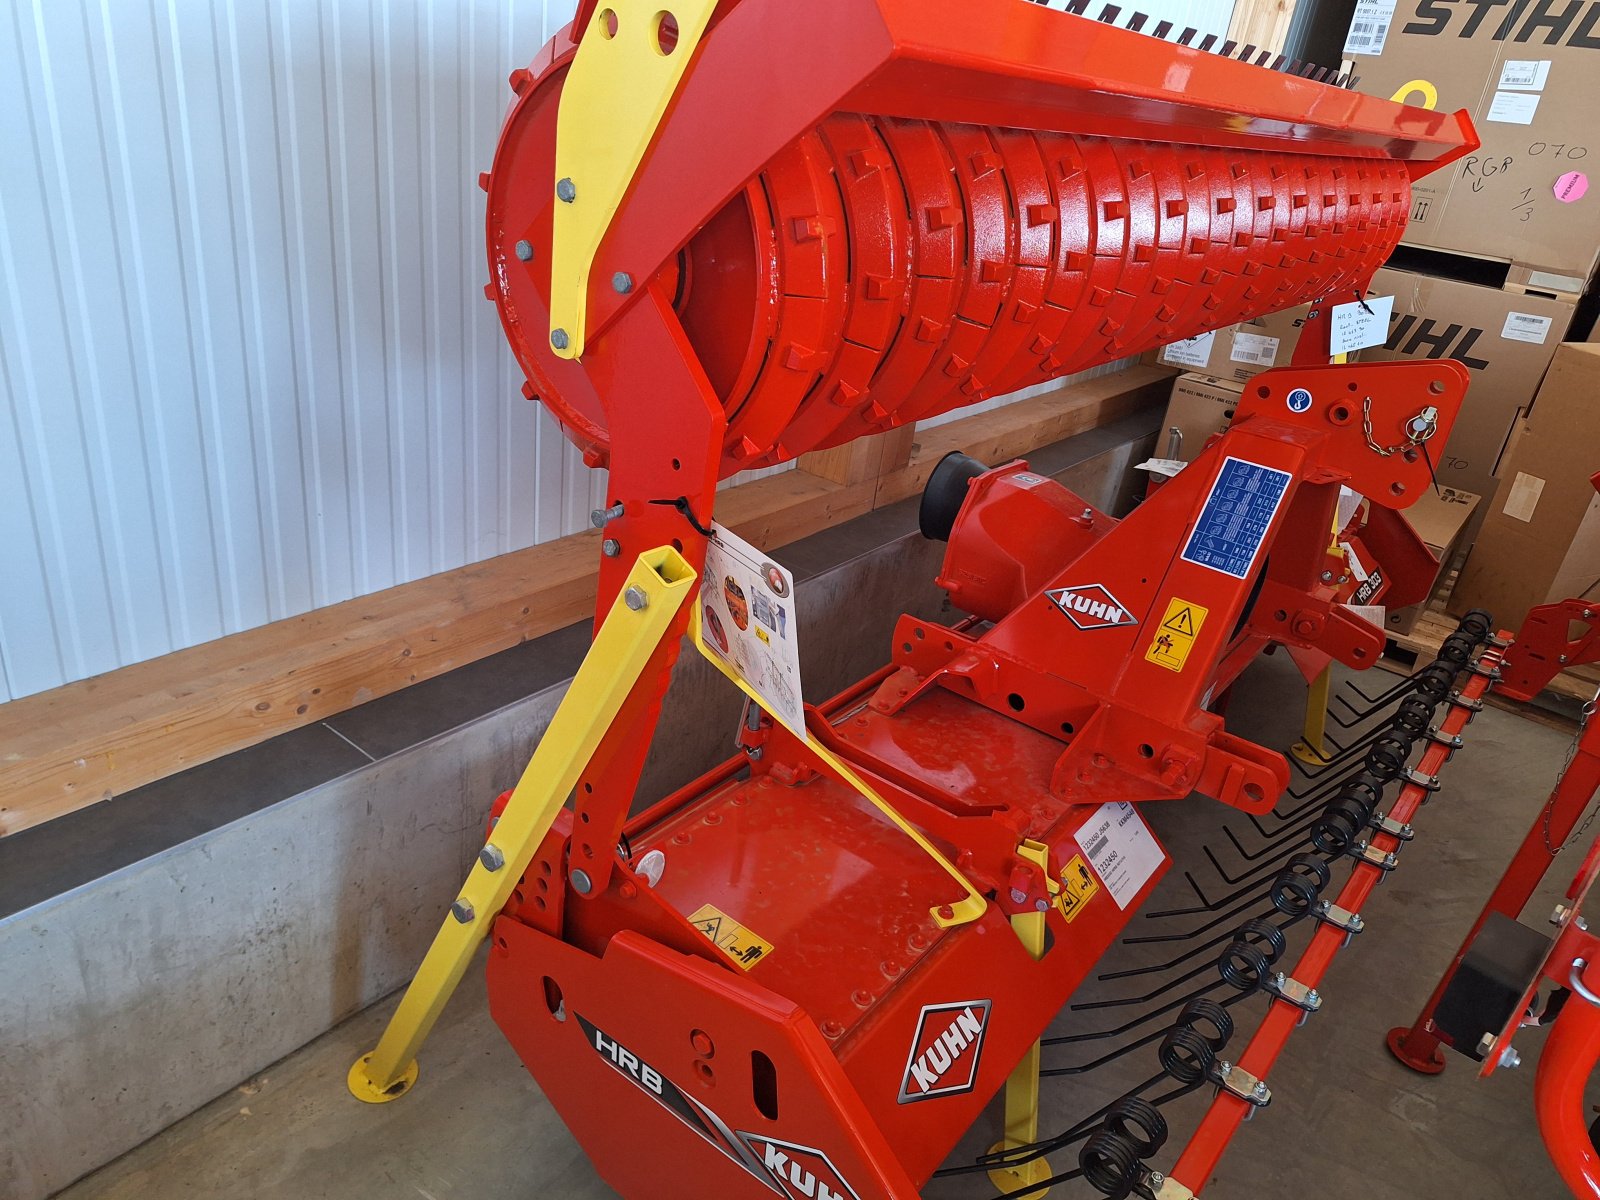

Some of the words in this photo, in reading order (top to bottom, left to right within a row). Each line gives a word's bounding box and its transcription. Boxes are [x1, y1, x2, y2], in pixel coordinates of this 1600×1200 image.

[1402, 0, 1600, 49] STIHL
[1528, 142, 1588, 160] 070
[1561, 174, 1580, 200] PREMIUM
[1383, 312, 1490, 370] IHL
[1356, 584, 1372, 603] HRB
[1368, 571, 1382, 589] 303
[1058, 590, 1123, 624] KUHN
[1098, 850, 1118, 874] 1232450
[595, 1029, 663, 1095] HRB
[910, 1006, 982, 1094] KUHN
